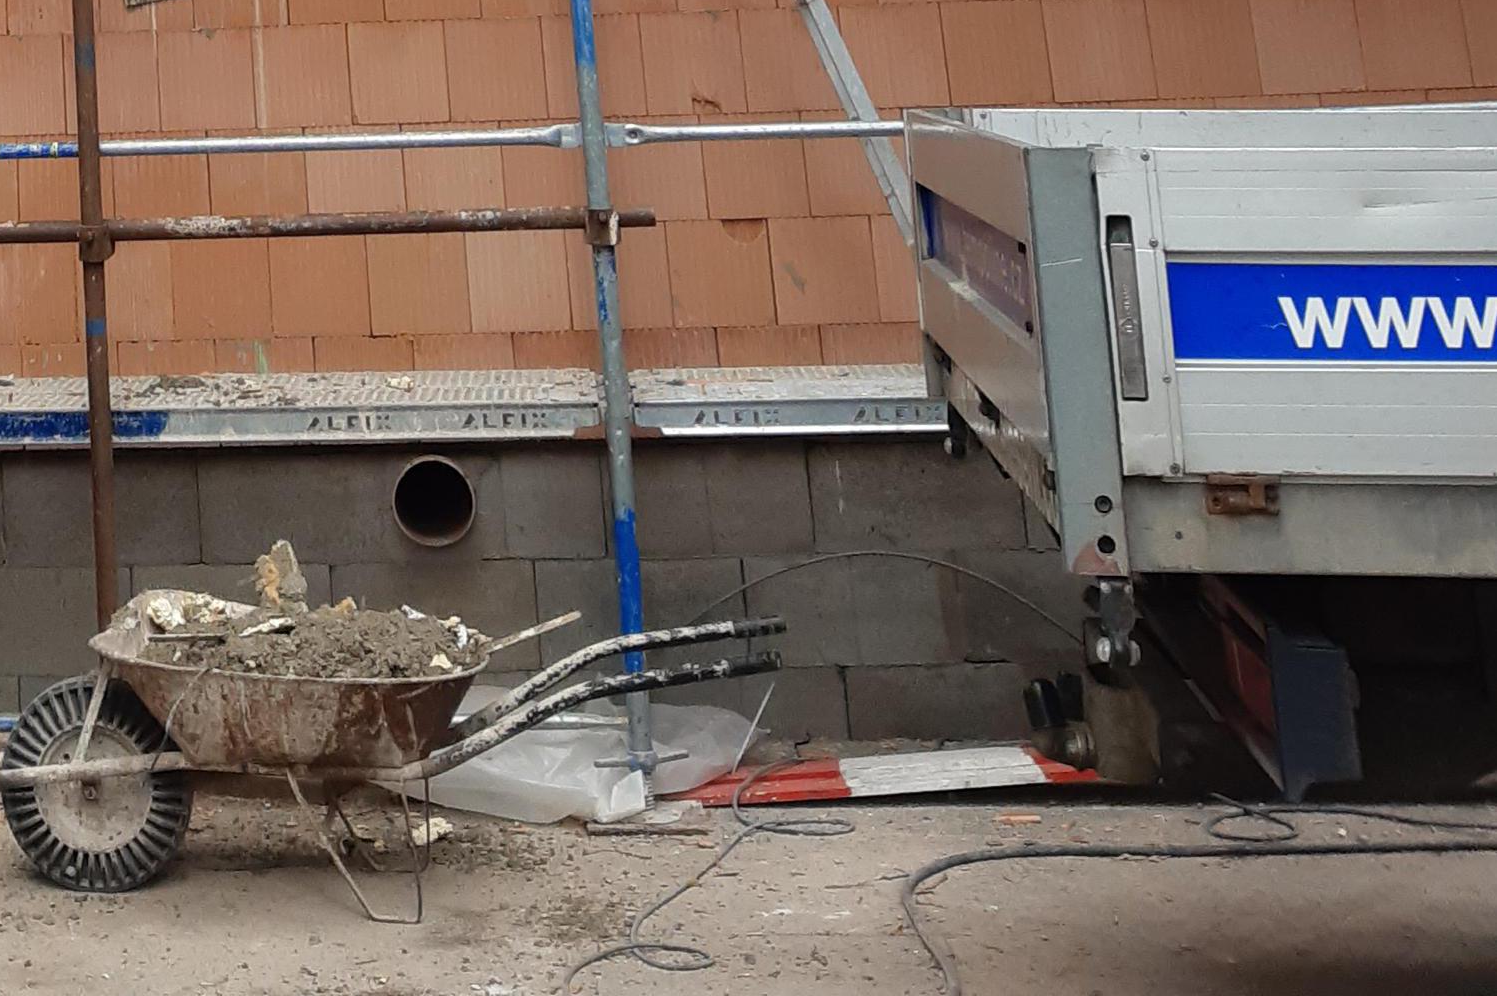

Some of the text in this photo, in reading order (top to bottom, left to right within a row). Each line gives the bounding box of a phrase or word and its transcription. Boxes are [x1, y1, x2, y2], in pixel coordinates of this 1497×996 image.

[307, 412, 546, 431] ALFIX ALFIX
[693, 405, 943, 425] ALFIX ALFIX
